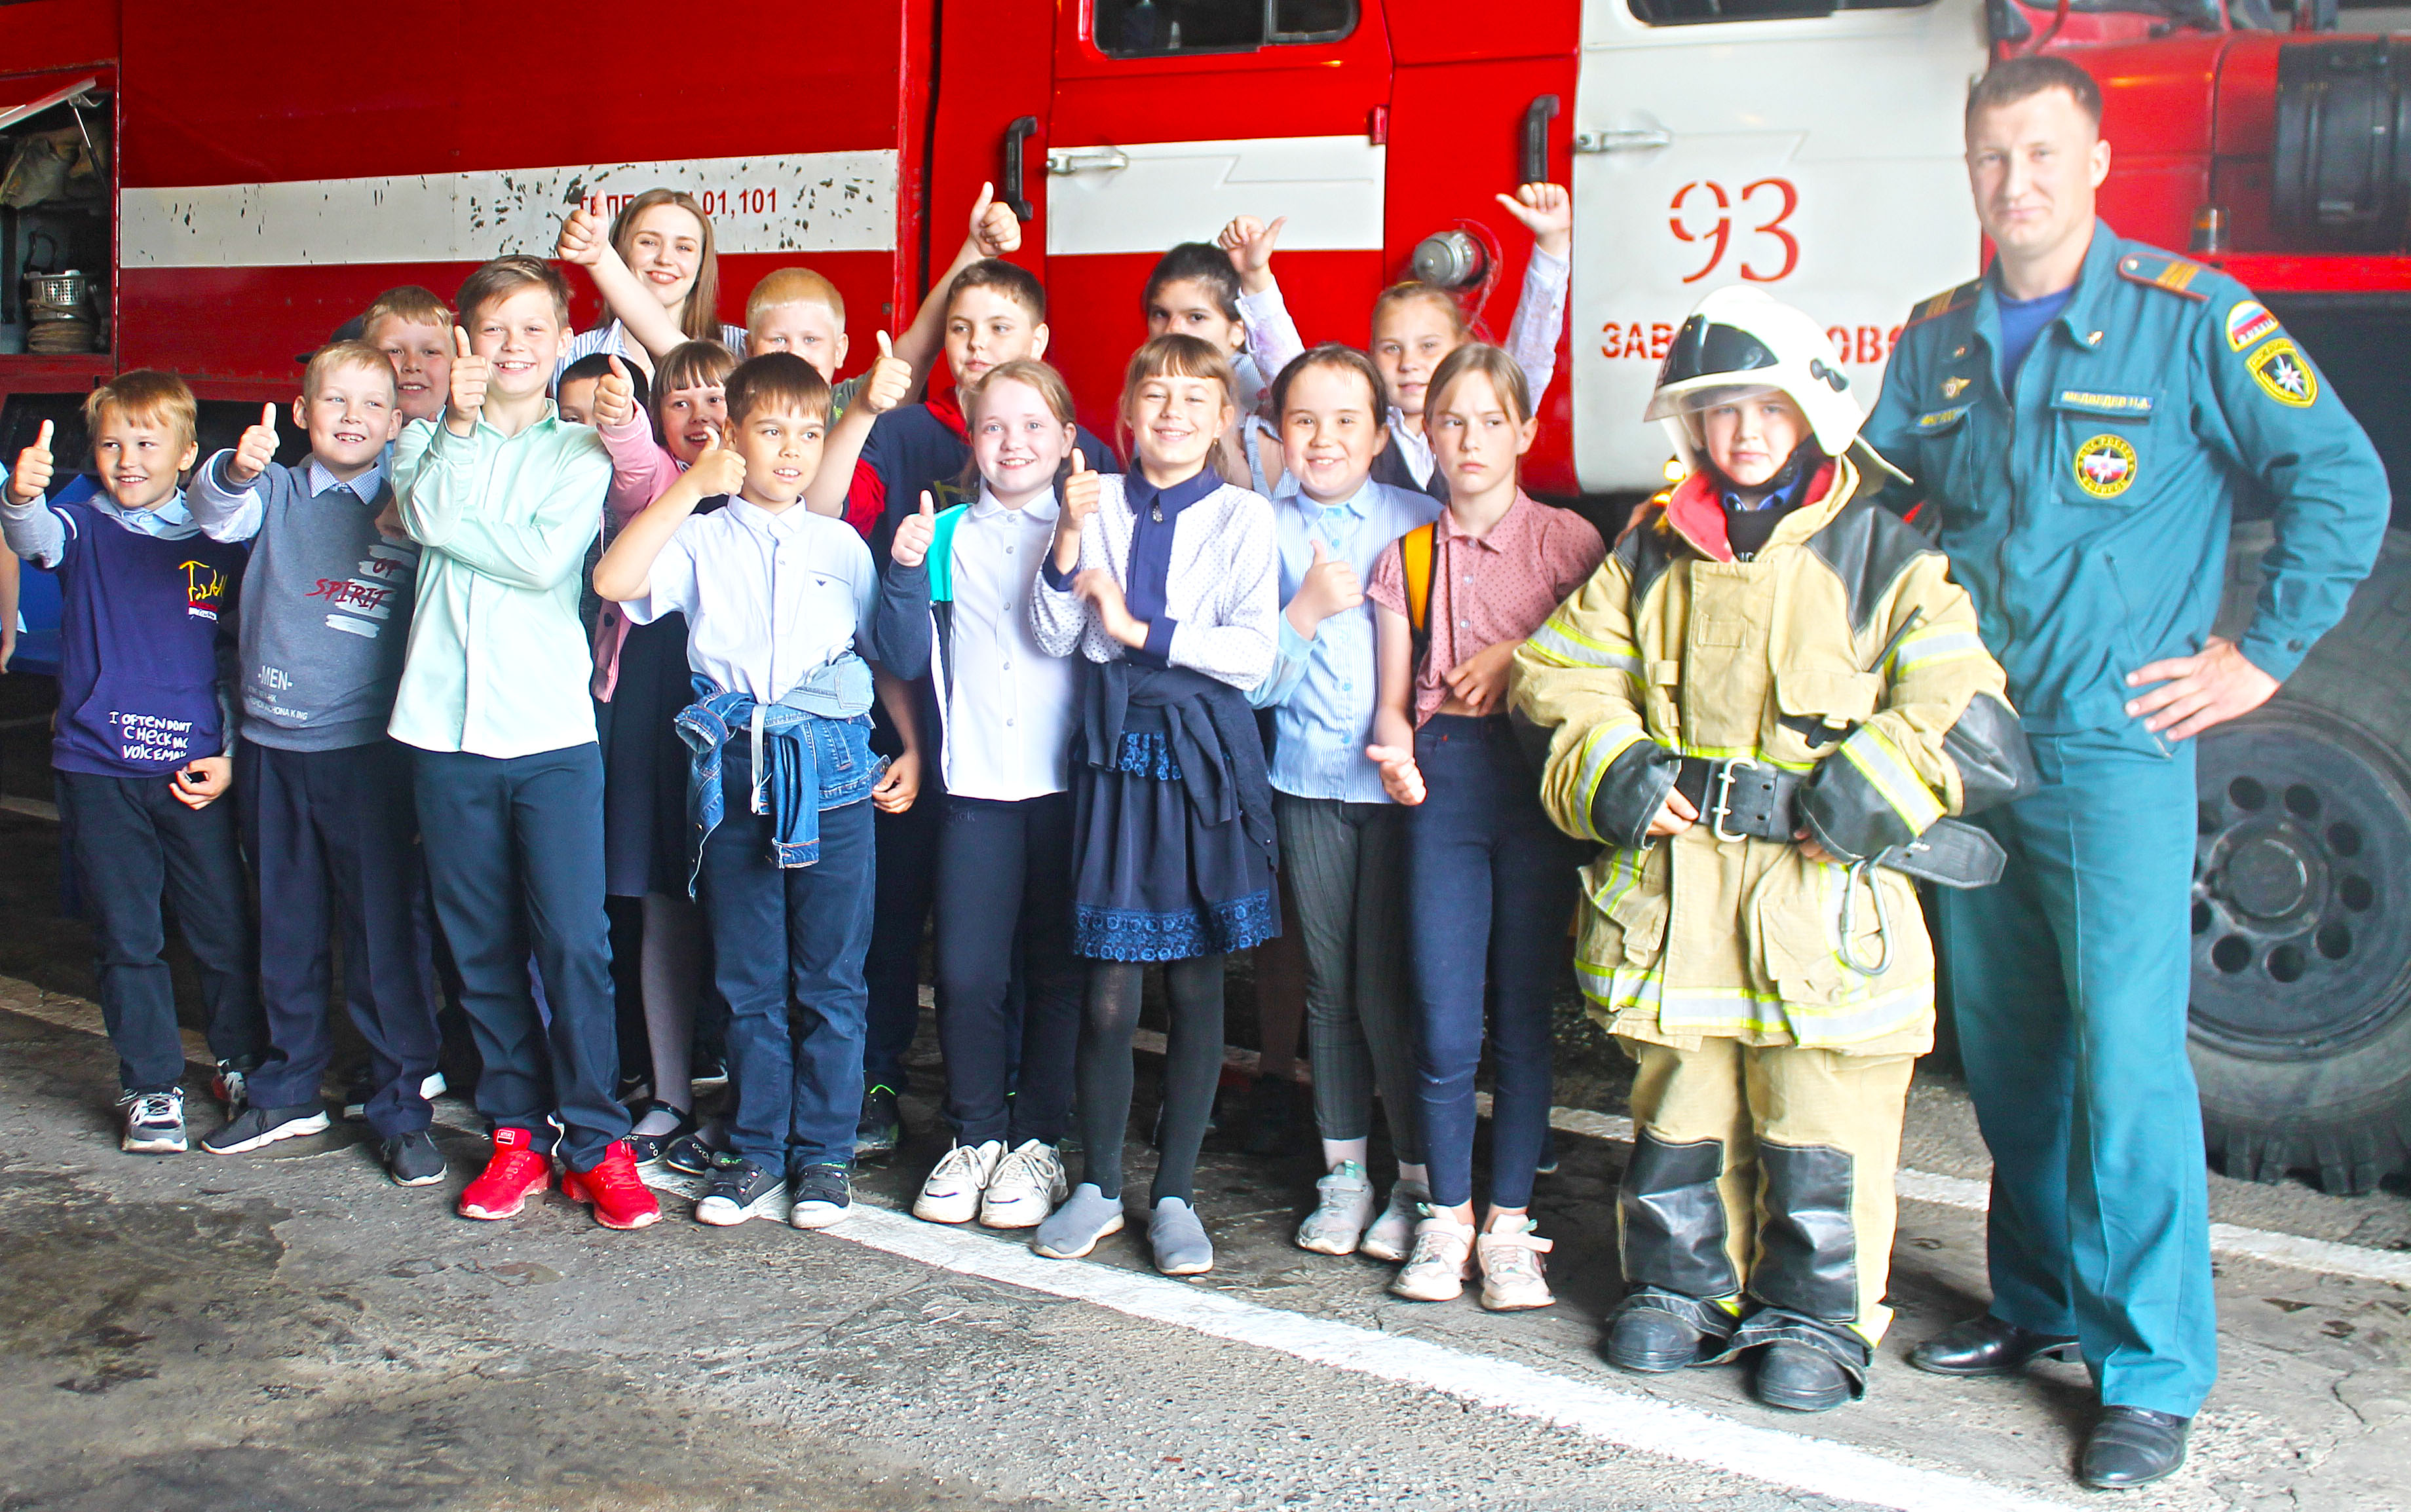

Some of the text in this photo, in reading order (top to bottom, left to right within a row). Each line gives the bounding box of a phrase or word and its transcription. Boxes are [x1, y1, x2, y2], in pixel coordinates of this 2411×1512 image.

[702, 187, 776, 218] 01,101
[1669, 176, 1800, 284] 93
[304, 578, 393, 611] SPIRIT
[109, 711, 119, 724] I
